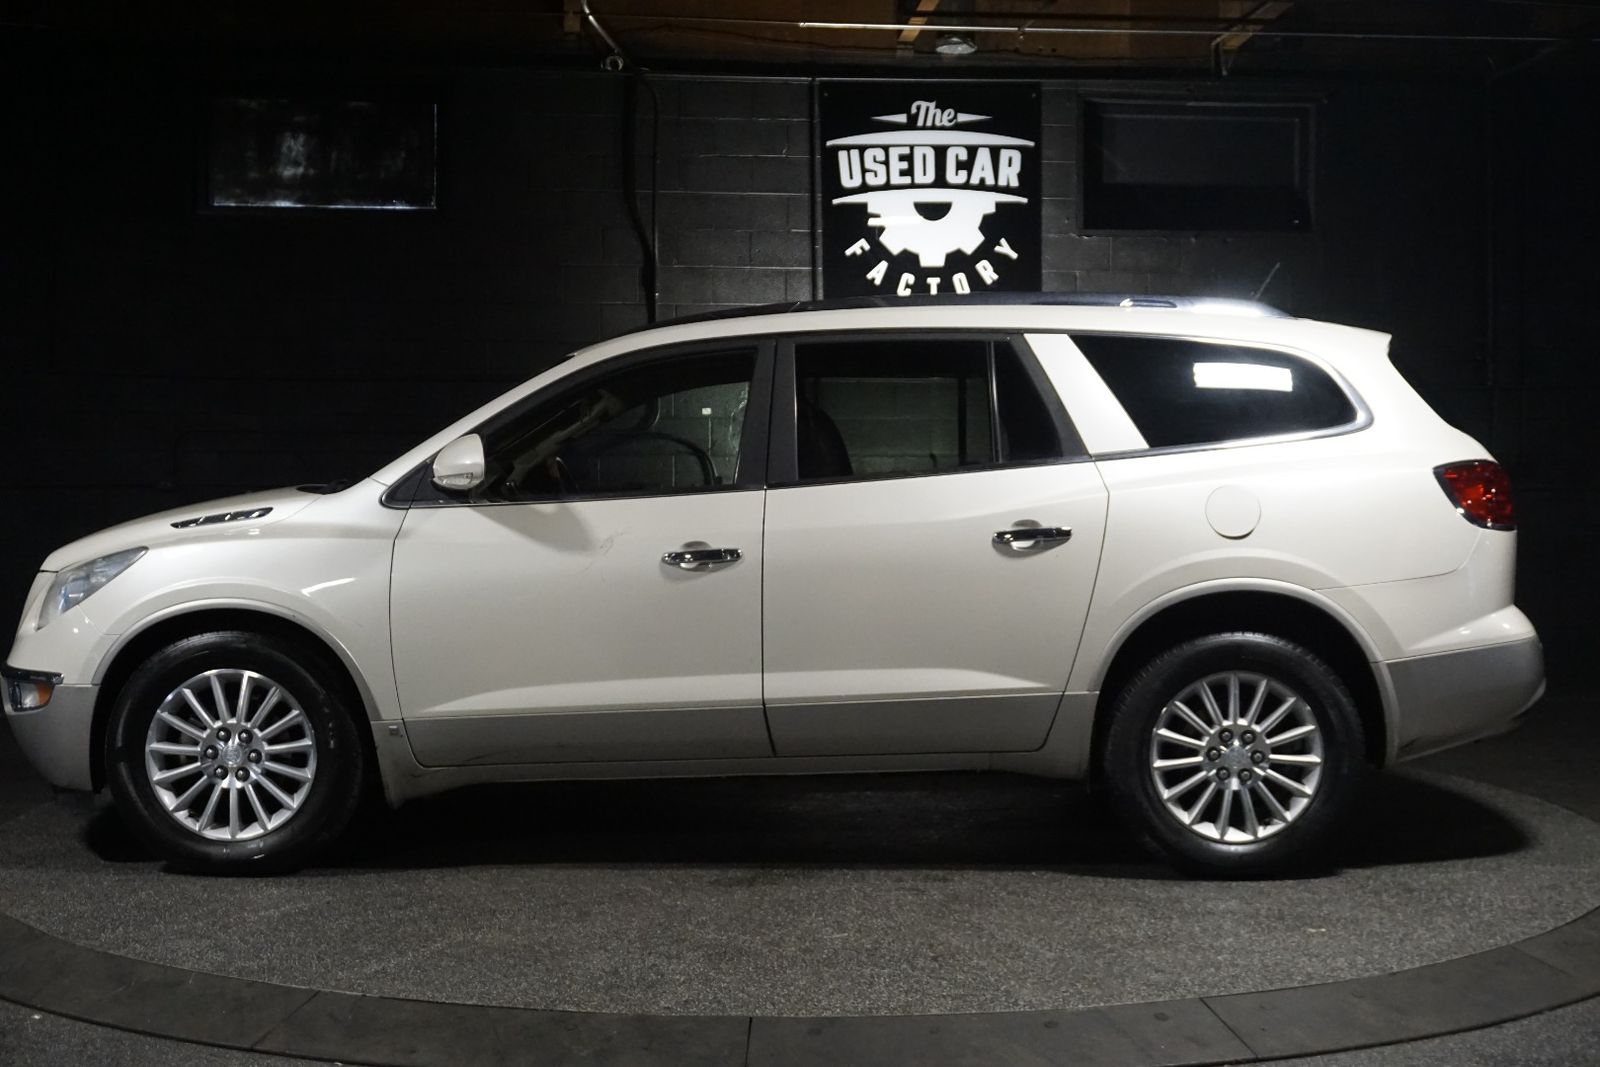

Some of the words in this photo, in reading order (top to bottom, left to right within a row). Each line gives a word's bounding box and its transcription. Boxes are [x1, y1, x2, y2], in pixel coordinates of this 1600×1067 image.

[911, 100, 957, 127] The
[837, 146, 936, 188] USED
[946, 146, 1022, 187] CAR
[844, 238, 1018, 297] FACTORY
